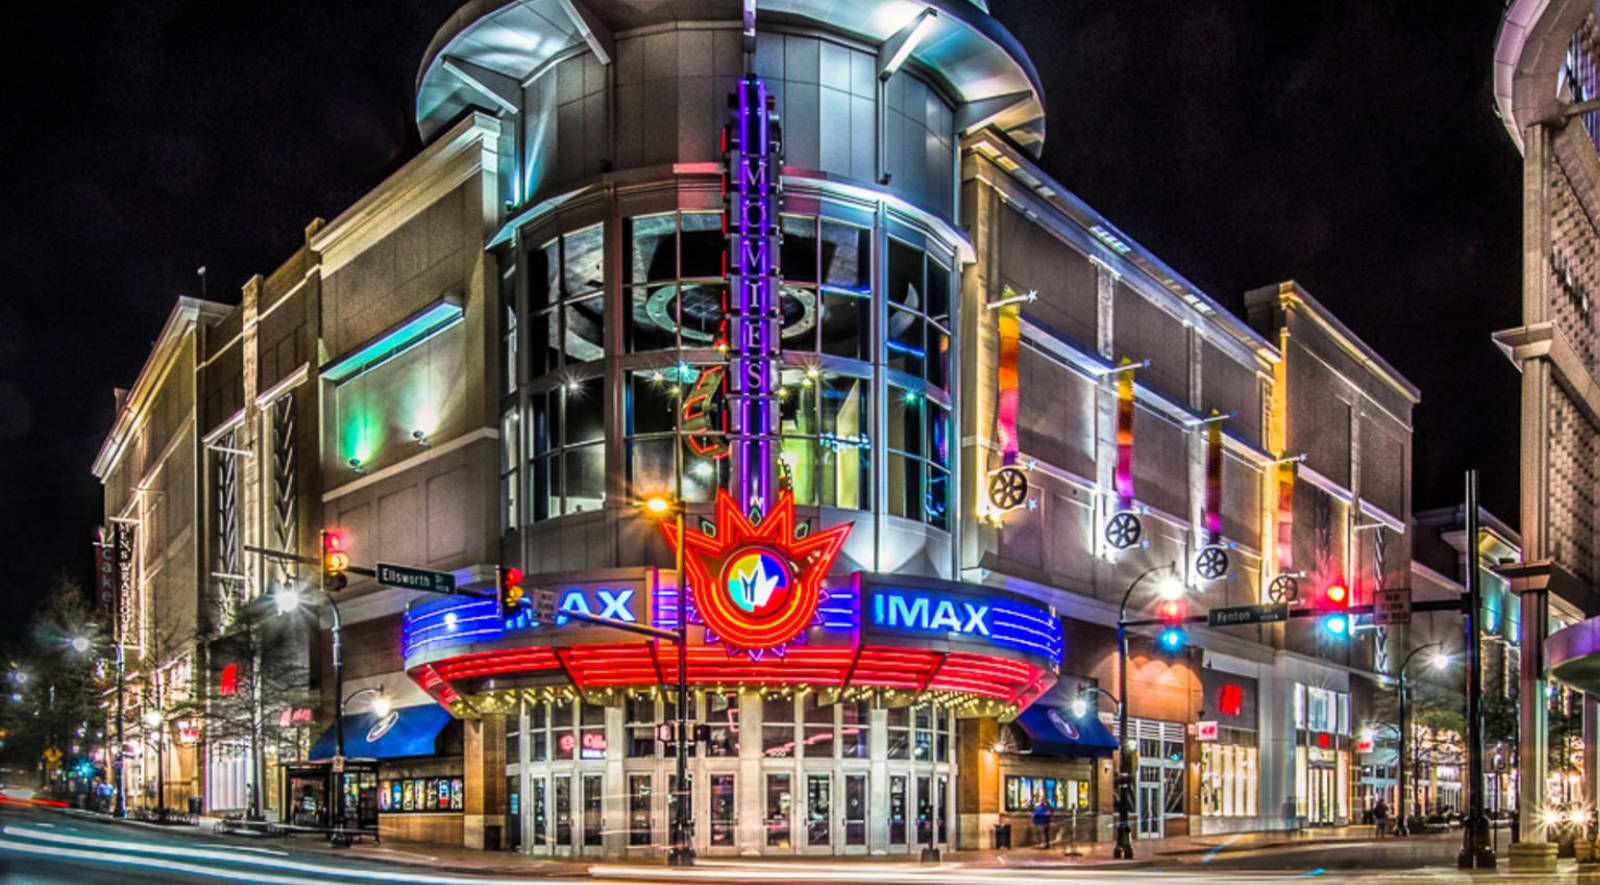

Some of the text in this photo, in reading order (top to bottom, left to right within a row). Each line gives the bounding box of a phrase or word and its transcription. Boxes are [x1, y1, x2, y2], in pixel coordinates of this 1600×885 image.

[743, 159, 768, 389] MOVIES
[382, 567, 431, 587] Ellsworth
[874, 593, 991, 635] IMAX
[1216, 610, 1251, 624] Fenton
